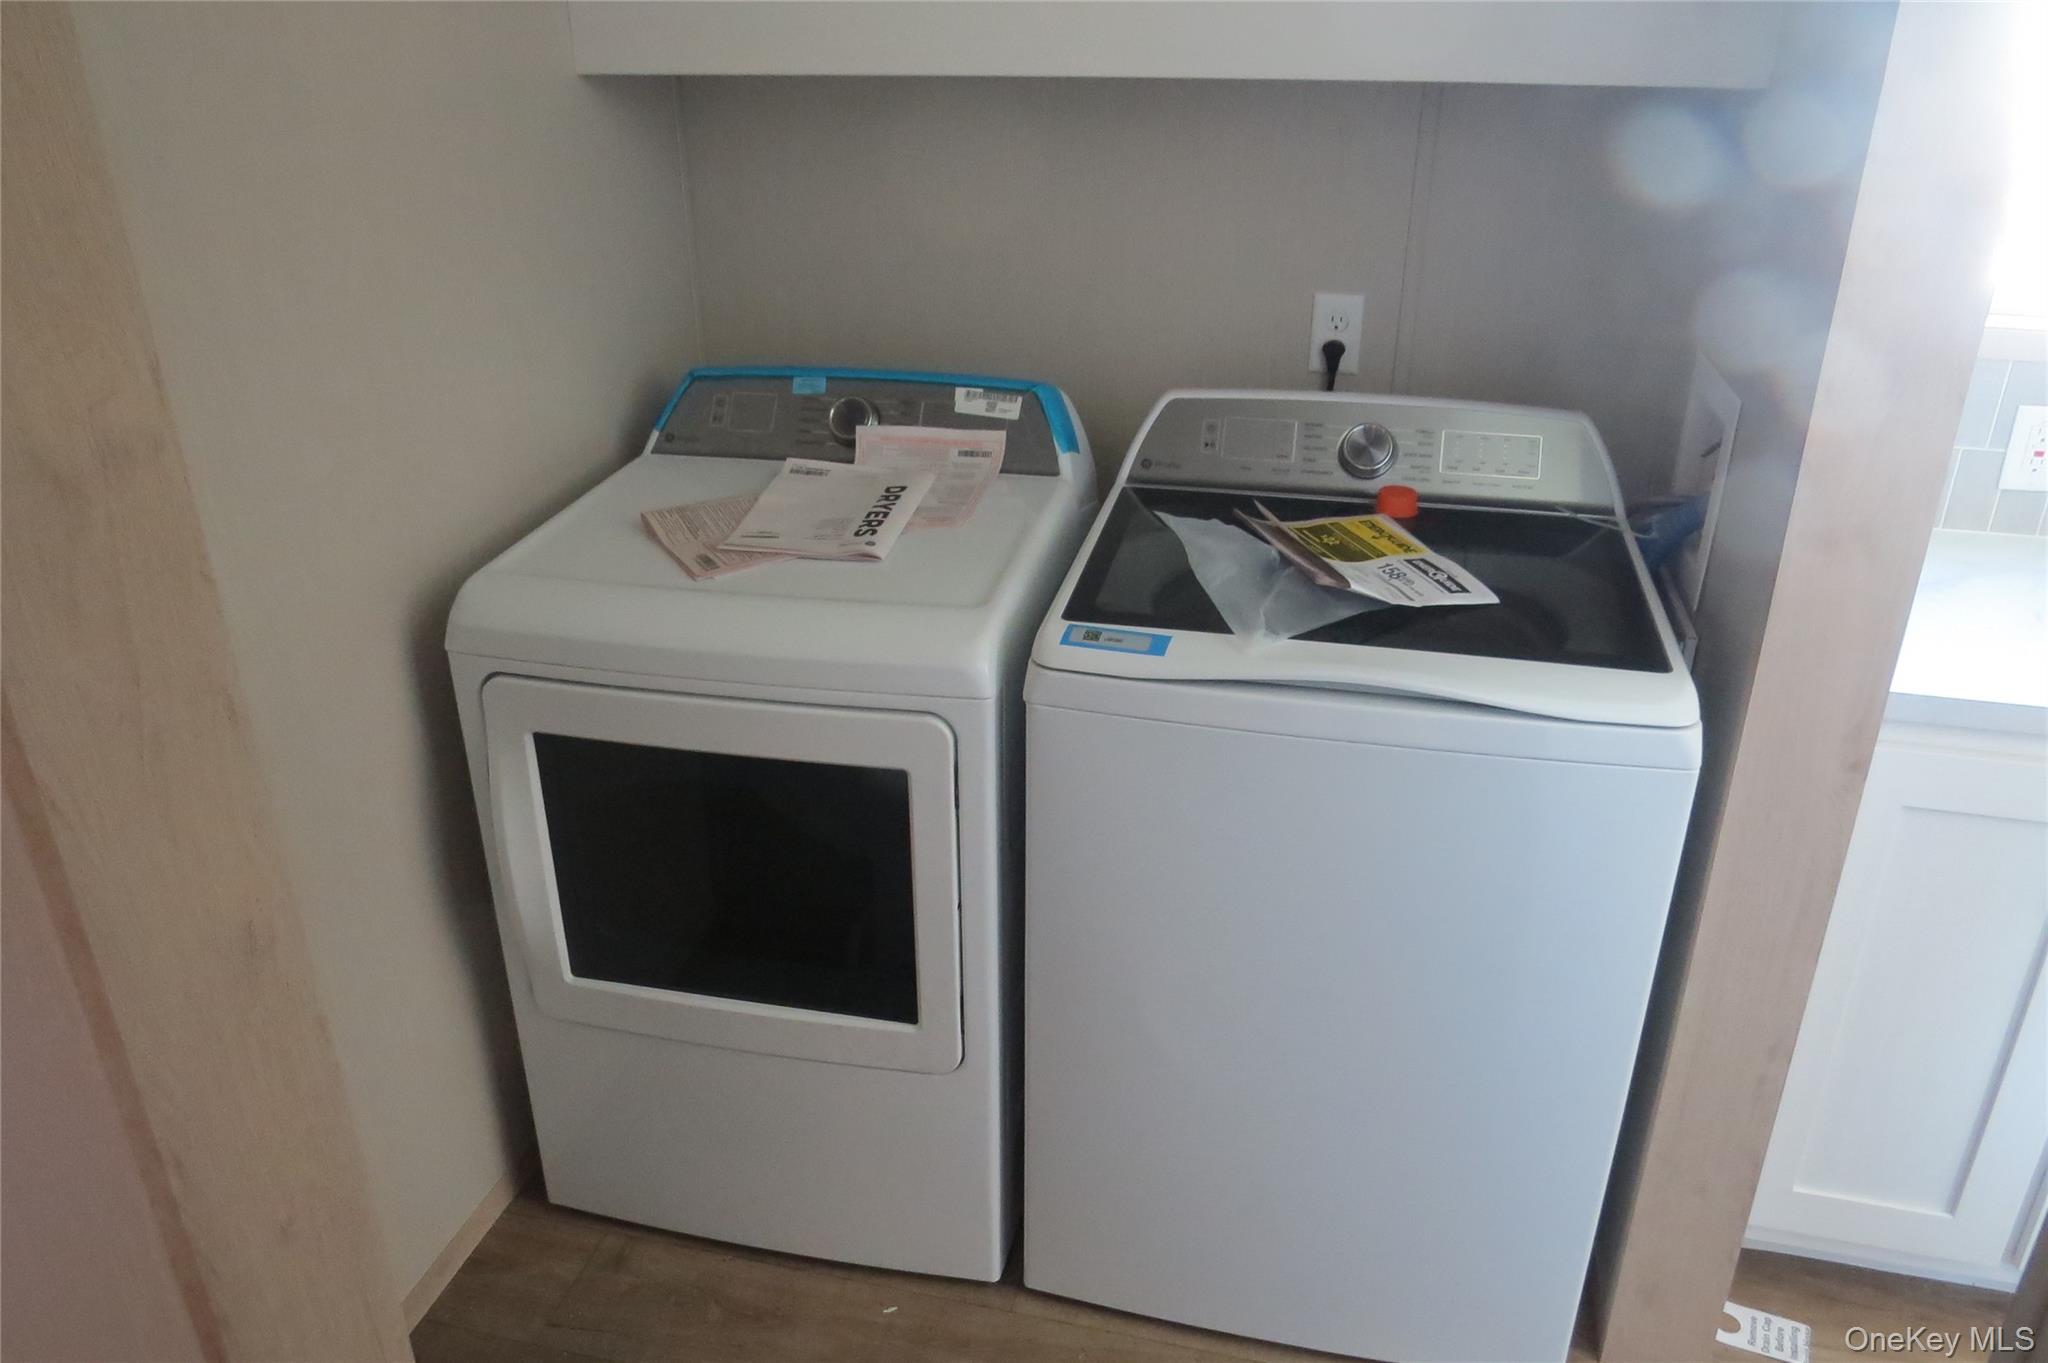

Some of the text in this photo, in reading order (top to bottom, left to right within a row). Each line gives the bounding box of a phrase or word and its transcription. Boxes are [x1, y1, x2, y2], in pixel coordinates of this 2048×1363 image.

[853, 486, 908, 537] DRYERS
[1377, 563, 1407, 581] 158
[1747, 1316, 1757, 1347] Remove
[1775, 1326, 1785, 1352] Before
